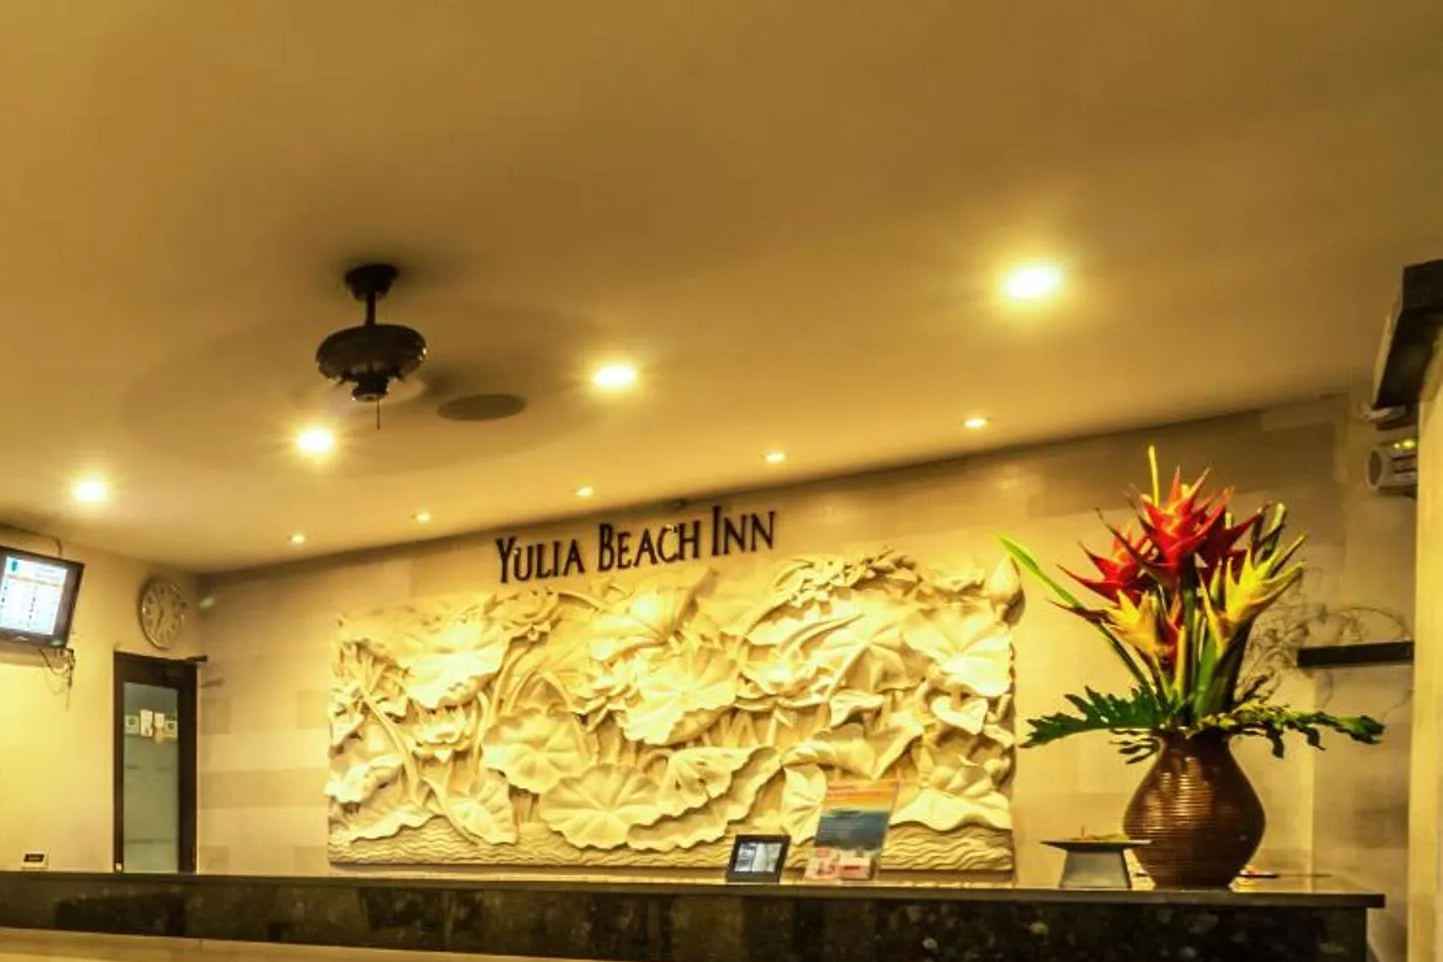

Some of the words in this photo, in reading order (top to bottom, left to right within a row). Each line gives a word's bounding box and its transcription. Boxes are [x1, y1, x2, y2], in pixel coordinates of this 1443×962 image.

[495, 536, 585, 583] YULIA
[598, 520, 701, 572] BEACH
[711, 505, 776, 557] INN
